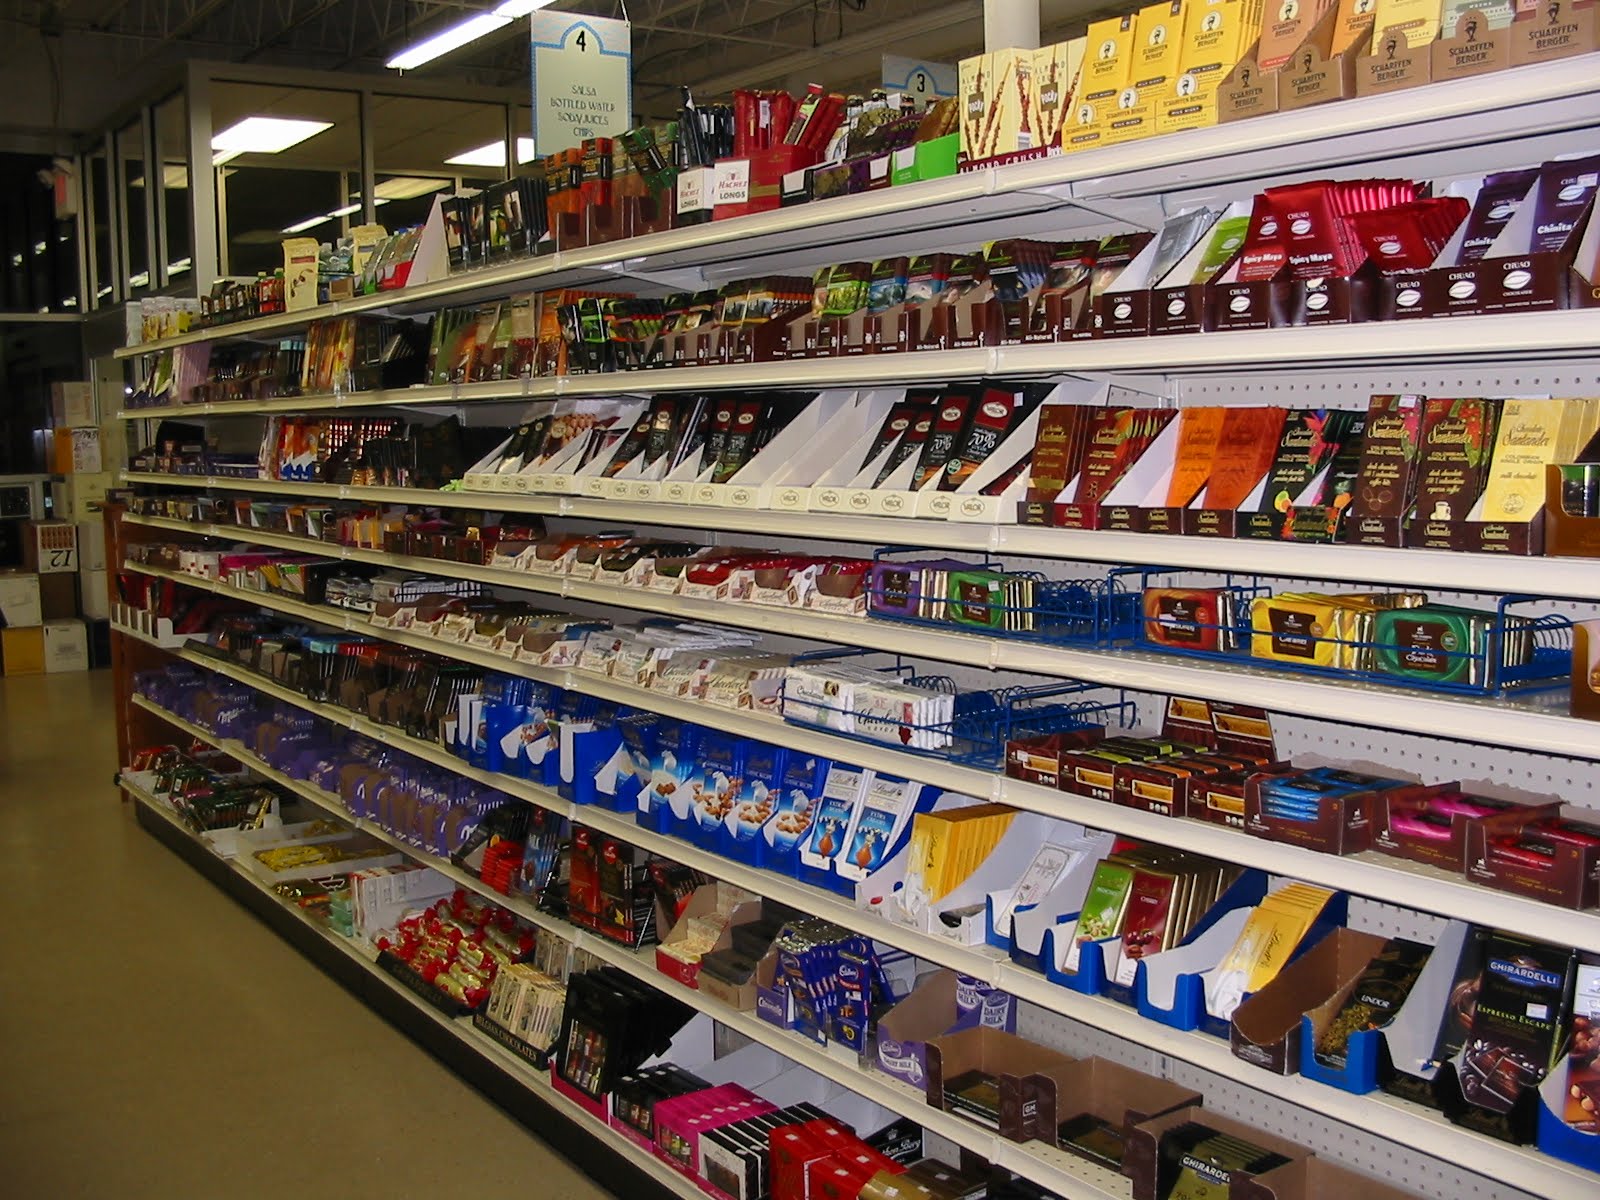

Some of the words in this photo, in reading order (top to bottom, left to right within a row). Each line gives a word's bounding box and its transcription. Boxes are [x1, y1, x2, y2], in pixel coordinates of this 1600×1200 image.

[1529, 24, 1579, 40] SCHARFFEN
[576, 31, 586, 51] 4
[1536, 36, 1571, 49] BERGER
[1449, 41, 1494, 57] SCHARFFEN
[1455, 53, 1488, 66] BERGER
[1376, 69, 1405, 83] BERGER
[917, 74, 925, 92] 3
[571, 85, 597, 97] SALSA
[550, 98, 587, 110] BOTTLED
[589, 101, 616, 112] WATER
[573, 127, 595, 137] CHIPS
[1005, 151, 1042, 167] CRUSH
[720, 189, 747, 202] LONGS
[1310, 253, 1334, 264] Maya
[1503, 261, 1531, 271] CHUAO
[1448, 271, 1476, 281] CHUAO
[1396, 280, 1421, 289] CHUAO
[967, 430, 998, 449] 70%
[1489, 961, 1558, 985] GHIRARDELLI
[1361, 994, 1391, 1009] LINDOR
[983, 1006, 1006, 1017] DAIRY
[1476, 1004, 1516, 1022] ESPRESSO
[1519, 1014, 1552, 1031] ESCAPE
[983, 1015, 1004, 1024] MILK
